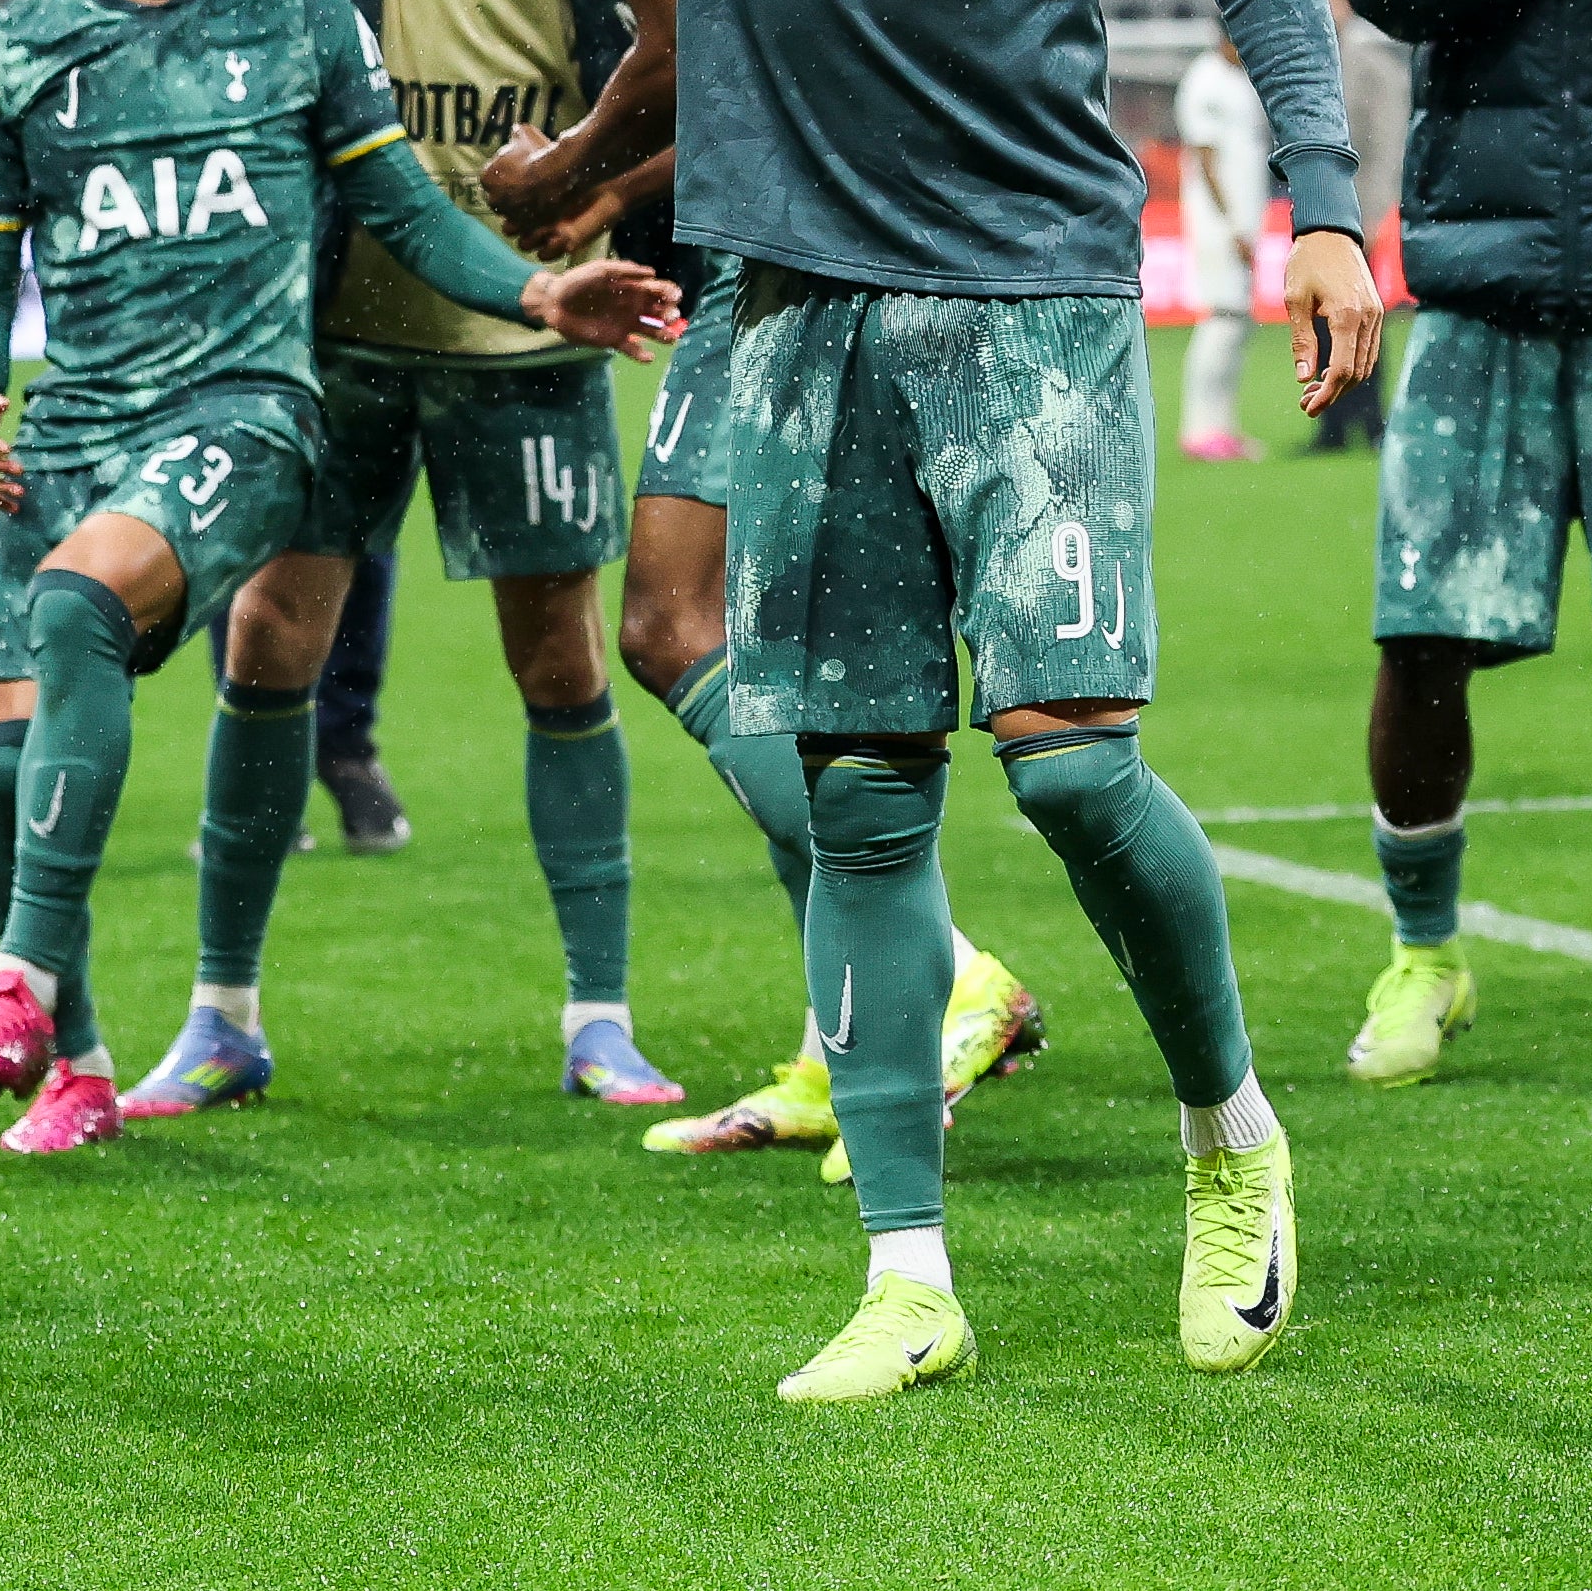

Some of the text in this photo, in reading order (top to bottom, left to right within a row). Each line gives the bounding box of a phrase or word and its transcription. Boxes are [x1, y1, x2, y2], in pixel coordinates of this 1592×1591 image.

[79, 148, 268, 252] AIA
[140, 434, 233, 506] 23
[521, 435, 575, 526] 14
[1051, 520, 1095, 640] 9
